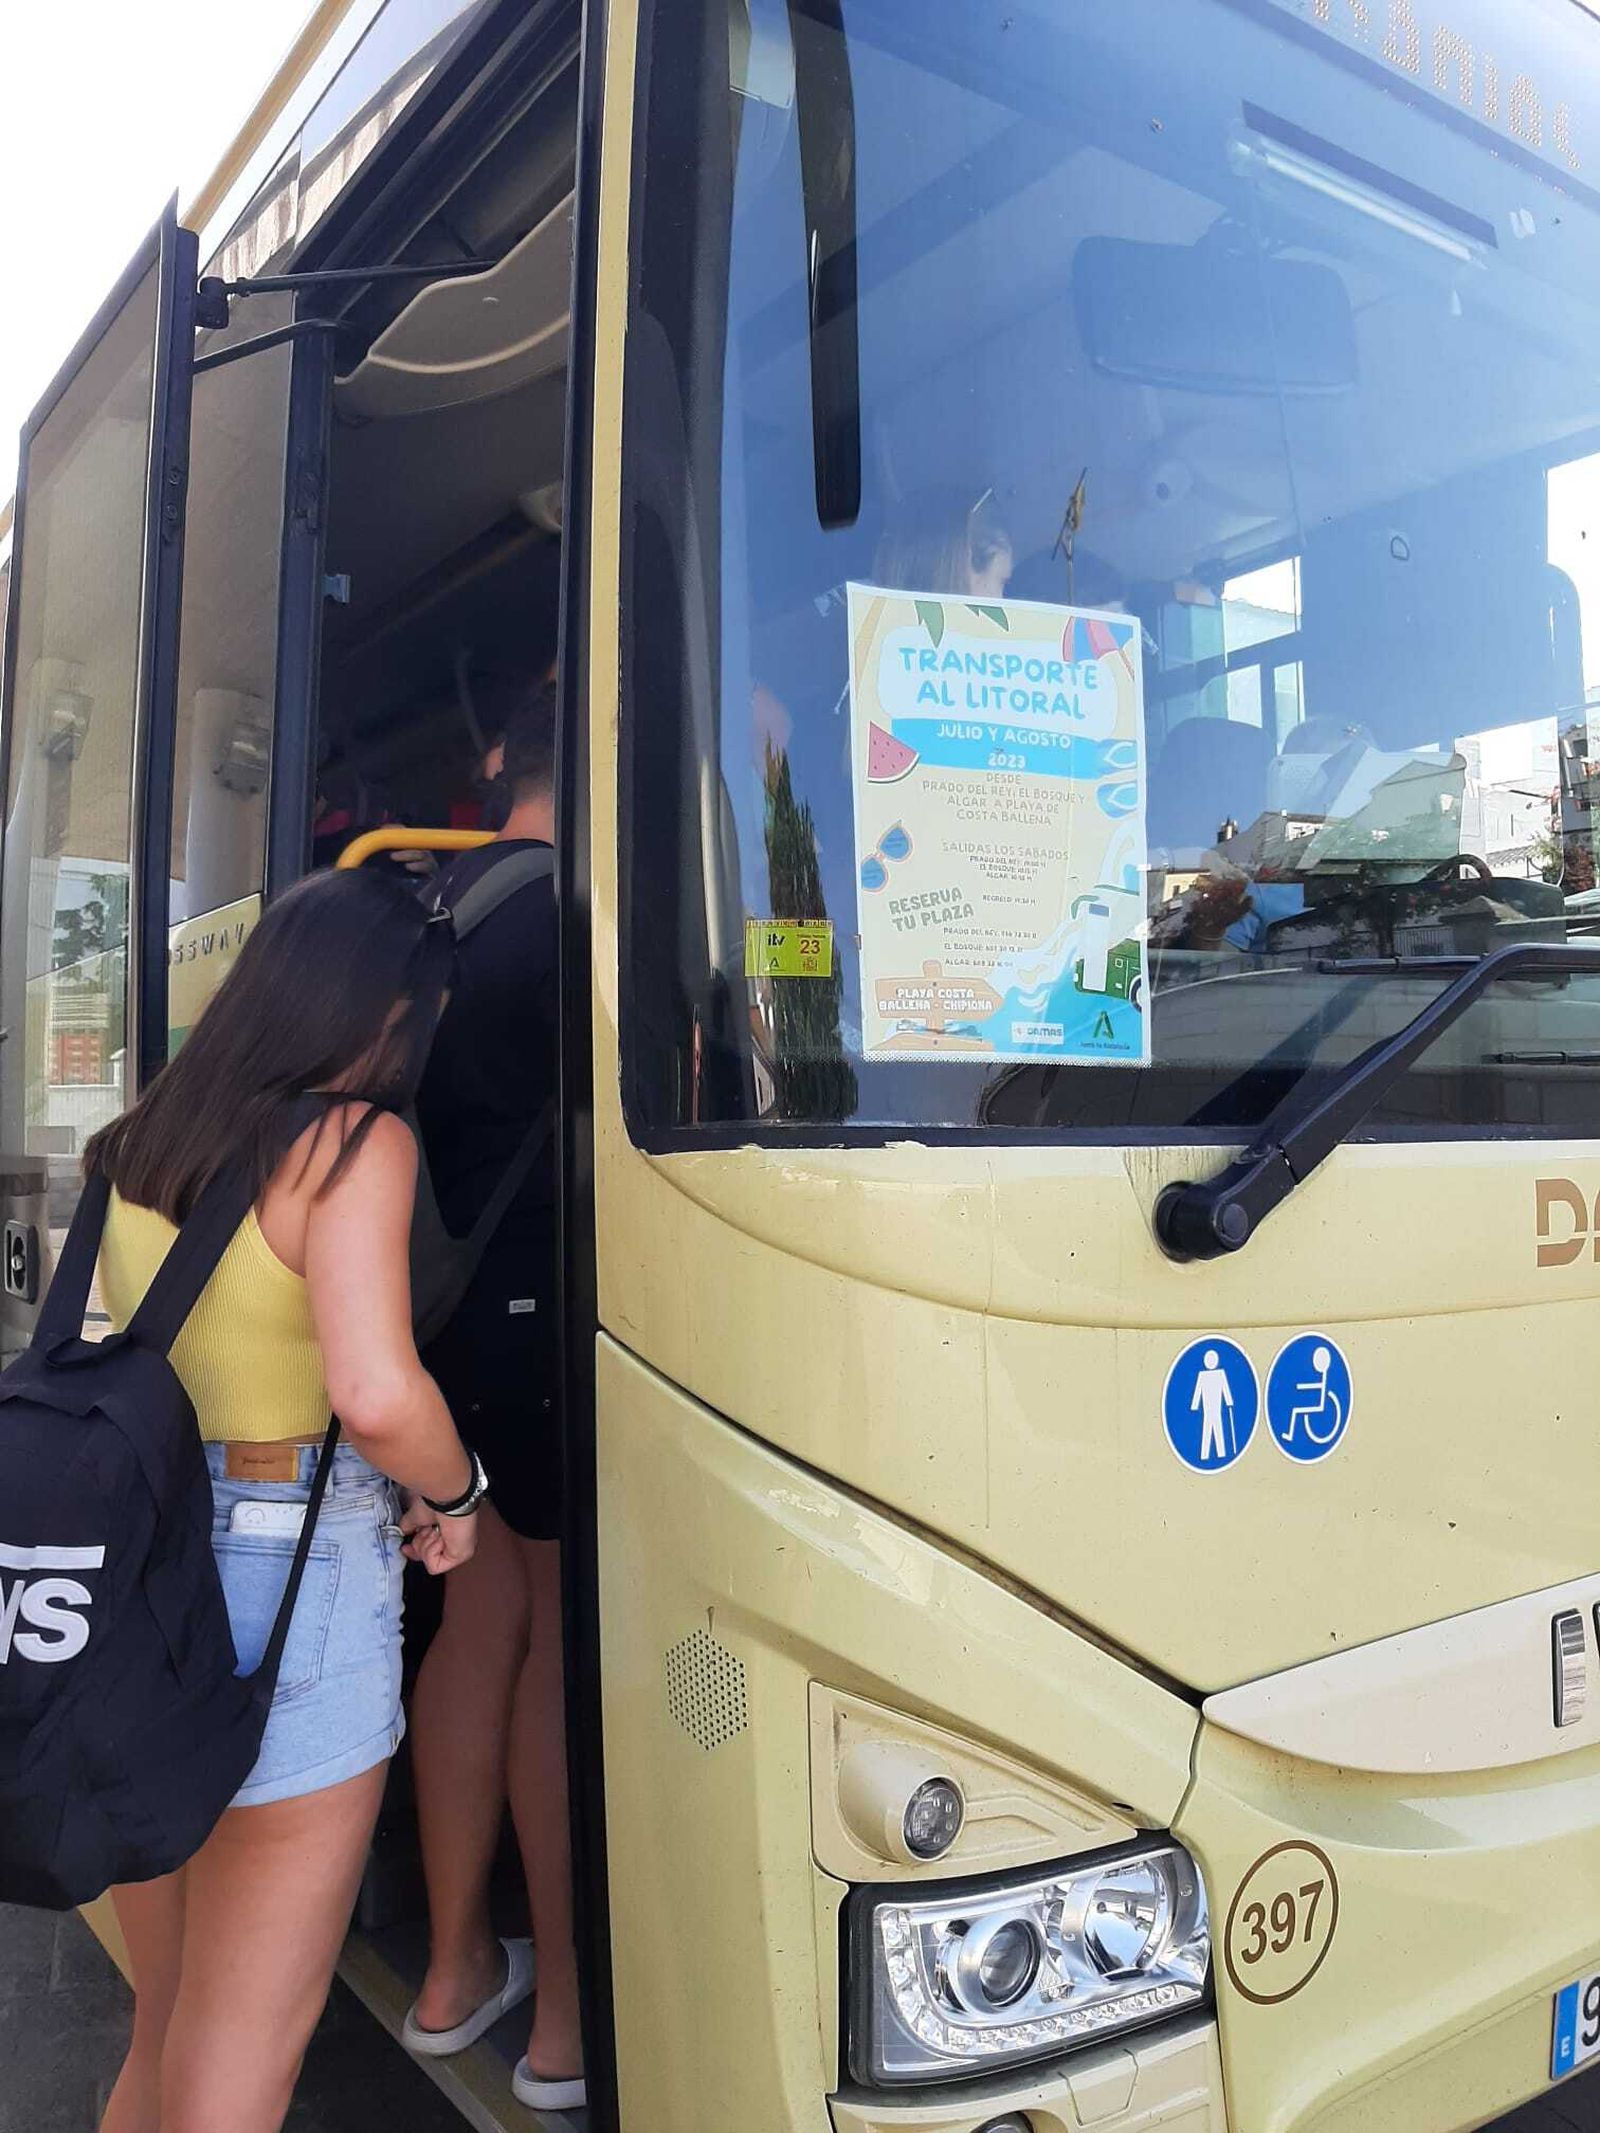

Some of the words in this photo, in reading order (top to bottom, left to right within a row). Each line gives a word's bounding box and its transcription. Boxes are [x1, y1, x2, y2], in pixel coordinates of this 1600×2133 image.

[899, 648, 1098, 689] TRANSPORTE
[917, 680, 955, 707] AL
[967, 682, 1087, 720] LITORAL
[937, 723, 983, 741] JULIO
[988, 729, 999, 742] Y
[1004, 730, 1071, 748] AGOSTO
[987, 753, 1026, 769] 2023
[986, 772, 1022, 785] DESDE
[922, 780, 964, 794] PRADO
[967, 784, 987, 796] DEL
[1018, 788, 1031, 798] EL
[1033, 788, 1076, 804] BOSQUE
[947, 795, 986, 808] ALGAR
[994, 798, 1002, 808] A
[1006, 799, 1043, 813] PLAYA
[1046, 803, 1059, 814] DE
[957, 809, 998, 822] COSTA
[1001, 812, 1052, 826] BALLENA
[942, 842, 991, 856] SALIDAS
[995, 845, 1015, 857] LOS
[889, 887, 962, 914] RESERVA
[892, 915, 916, 932] TU
[921, 903, 974, 926] PLAZA
[800, 939, 820, 955] 23
[897, 988, 934, 999] PLAYA
[937, 988, 974, 999] COSTA
[878, 1000, 931, 1011] BALLENA
[943, 1000, 993, 1011] CHIPIONA
[1534, 1178, 1600, 1267] D
[1240, 1879, 1325, 1965] 397
[1561, 2035, 1571, 2058] E
